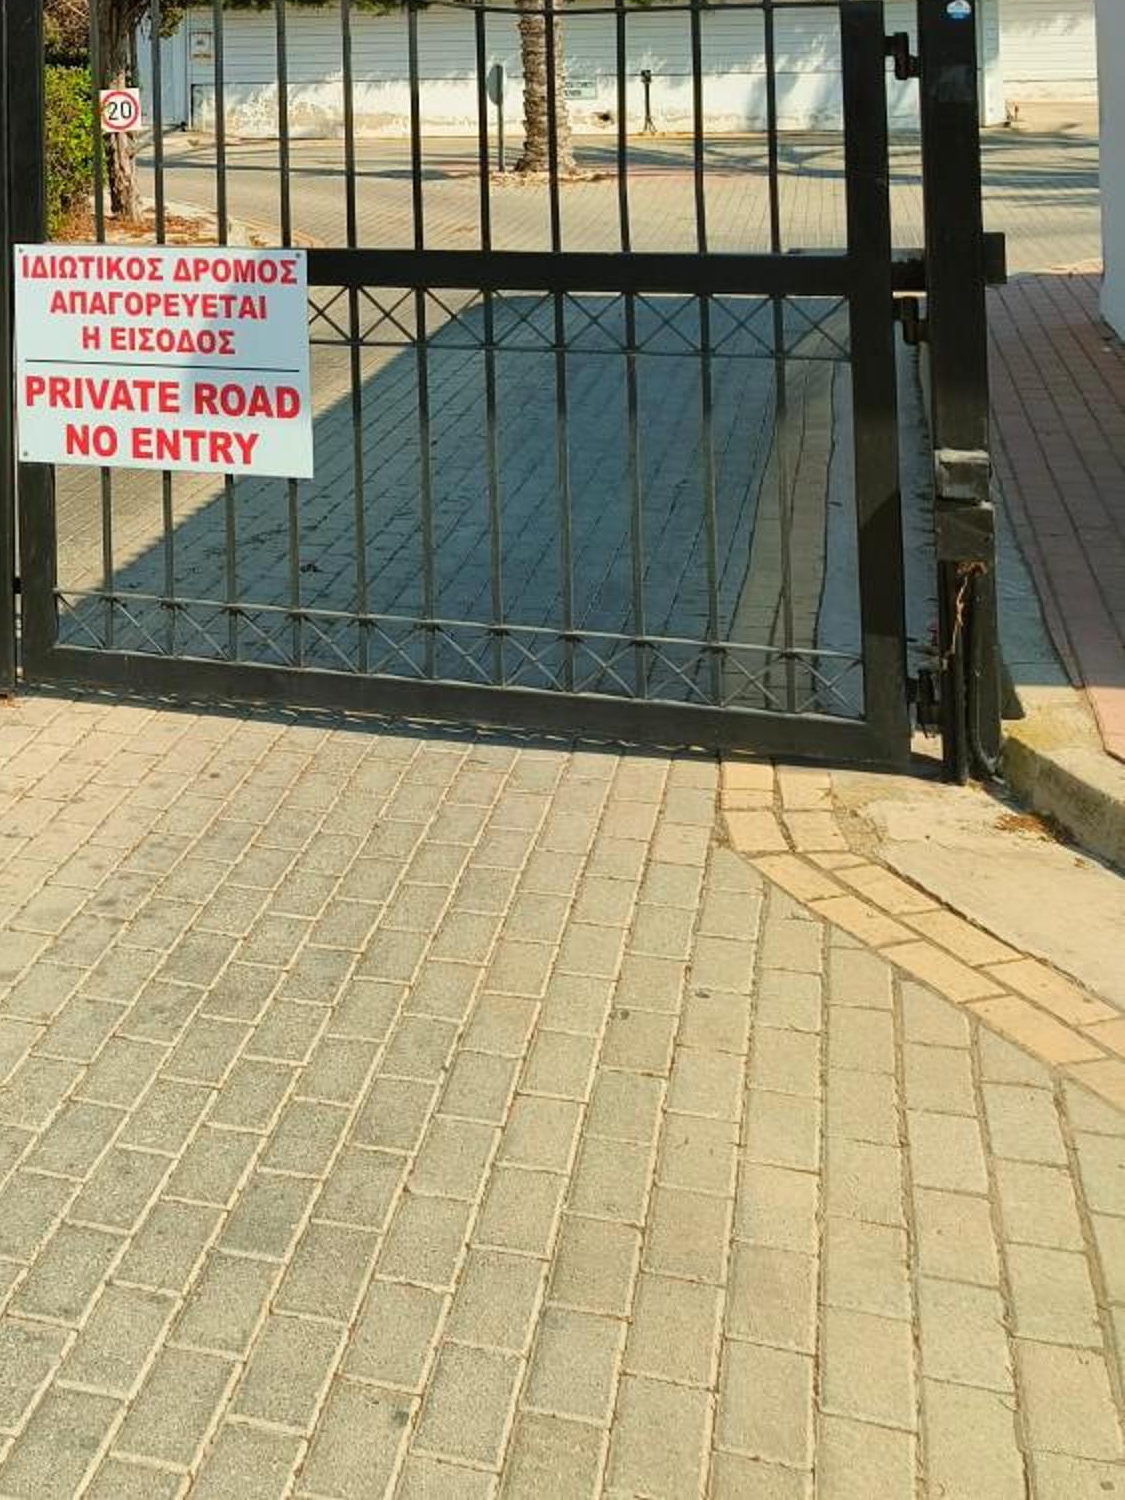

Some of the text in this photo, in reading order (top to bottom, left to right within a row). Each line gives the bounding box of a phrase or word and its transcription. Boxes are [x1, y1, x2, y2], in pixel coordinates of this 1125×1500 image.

[108, 101, 132, 121] 20
[21, 255, 298, 285] ΙΔΙΩΤΙΚΟΣ ΔΡΟΜΟΣ
[49, 290, 267, 320] ΑΠΑΓΟΡΕΥΕΤΑΙ
[81, 326, 236, 355] Η ΕΙΣΟΔΟΣ
[24, 375, 300, 419] PRIVATE ROAD
[65, 424, 260, 465] NO ENTRY
